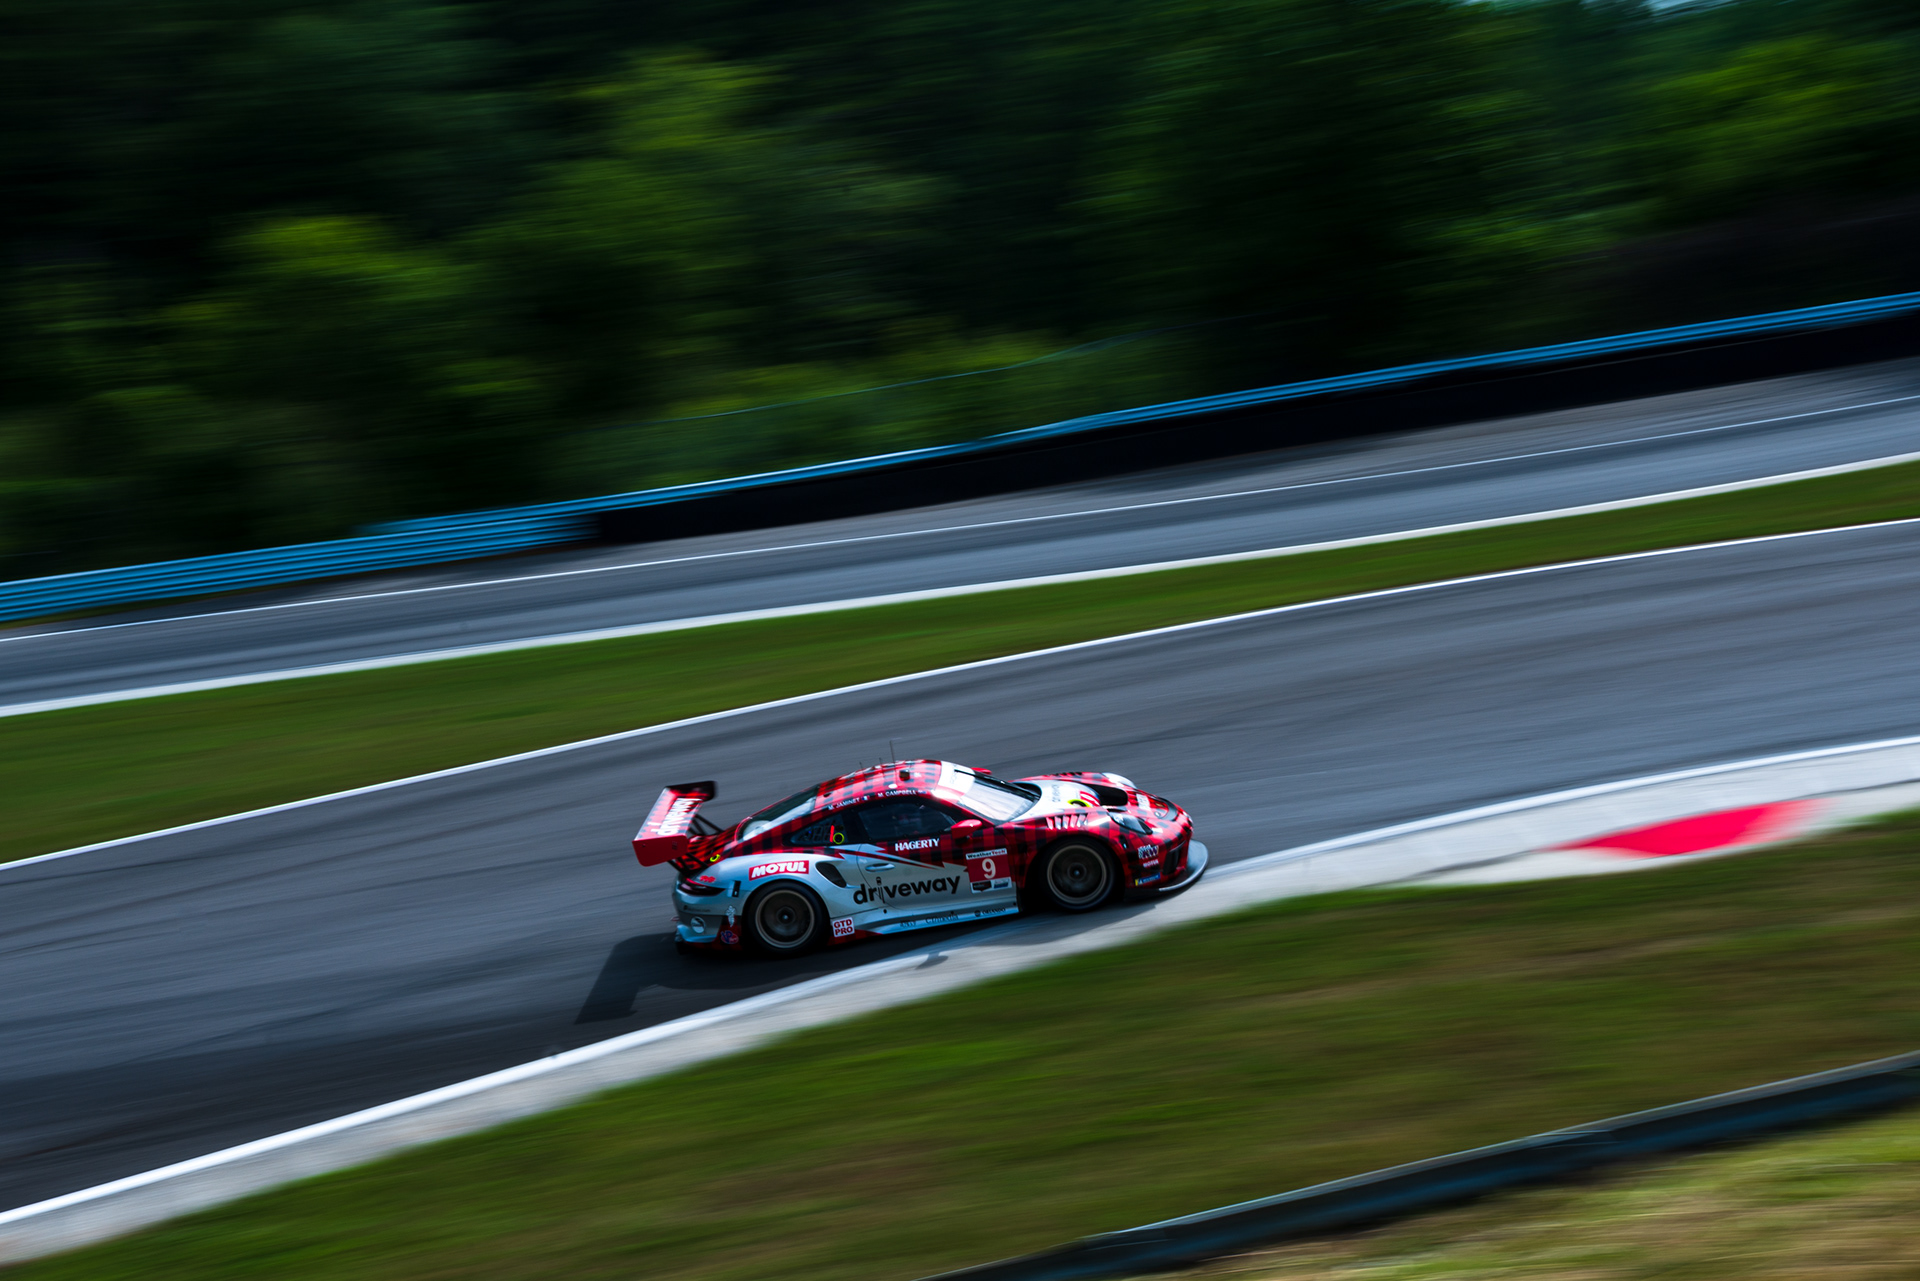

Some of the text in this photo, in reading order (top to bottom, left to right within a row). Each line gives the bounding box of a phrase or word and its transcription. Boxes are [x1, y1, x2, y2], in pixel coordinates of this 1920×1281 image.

[885, 789, 917, 797] CAMPBELL
[895, 838, 940, 851] HAGERTY
[967, 849, 1006, 858] WeatherTech
[751, 862, 807, 878] MOTUL
[982, 858, 996, 879] 9
[853, 876, 960, 905] driveway
[833, 919, 852, 929] GTD
[835, 927, 853, 936] PRO
